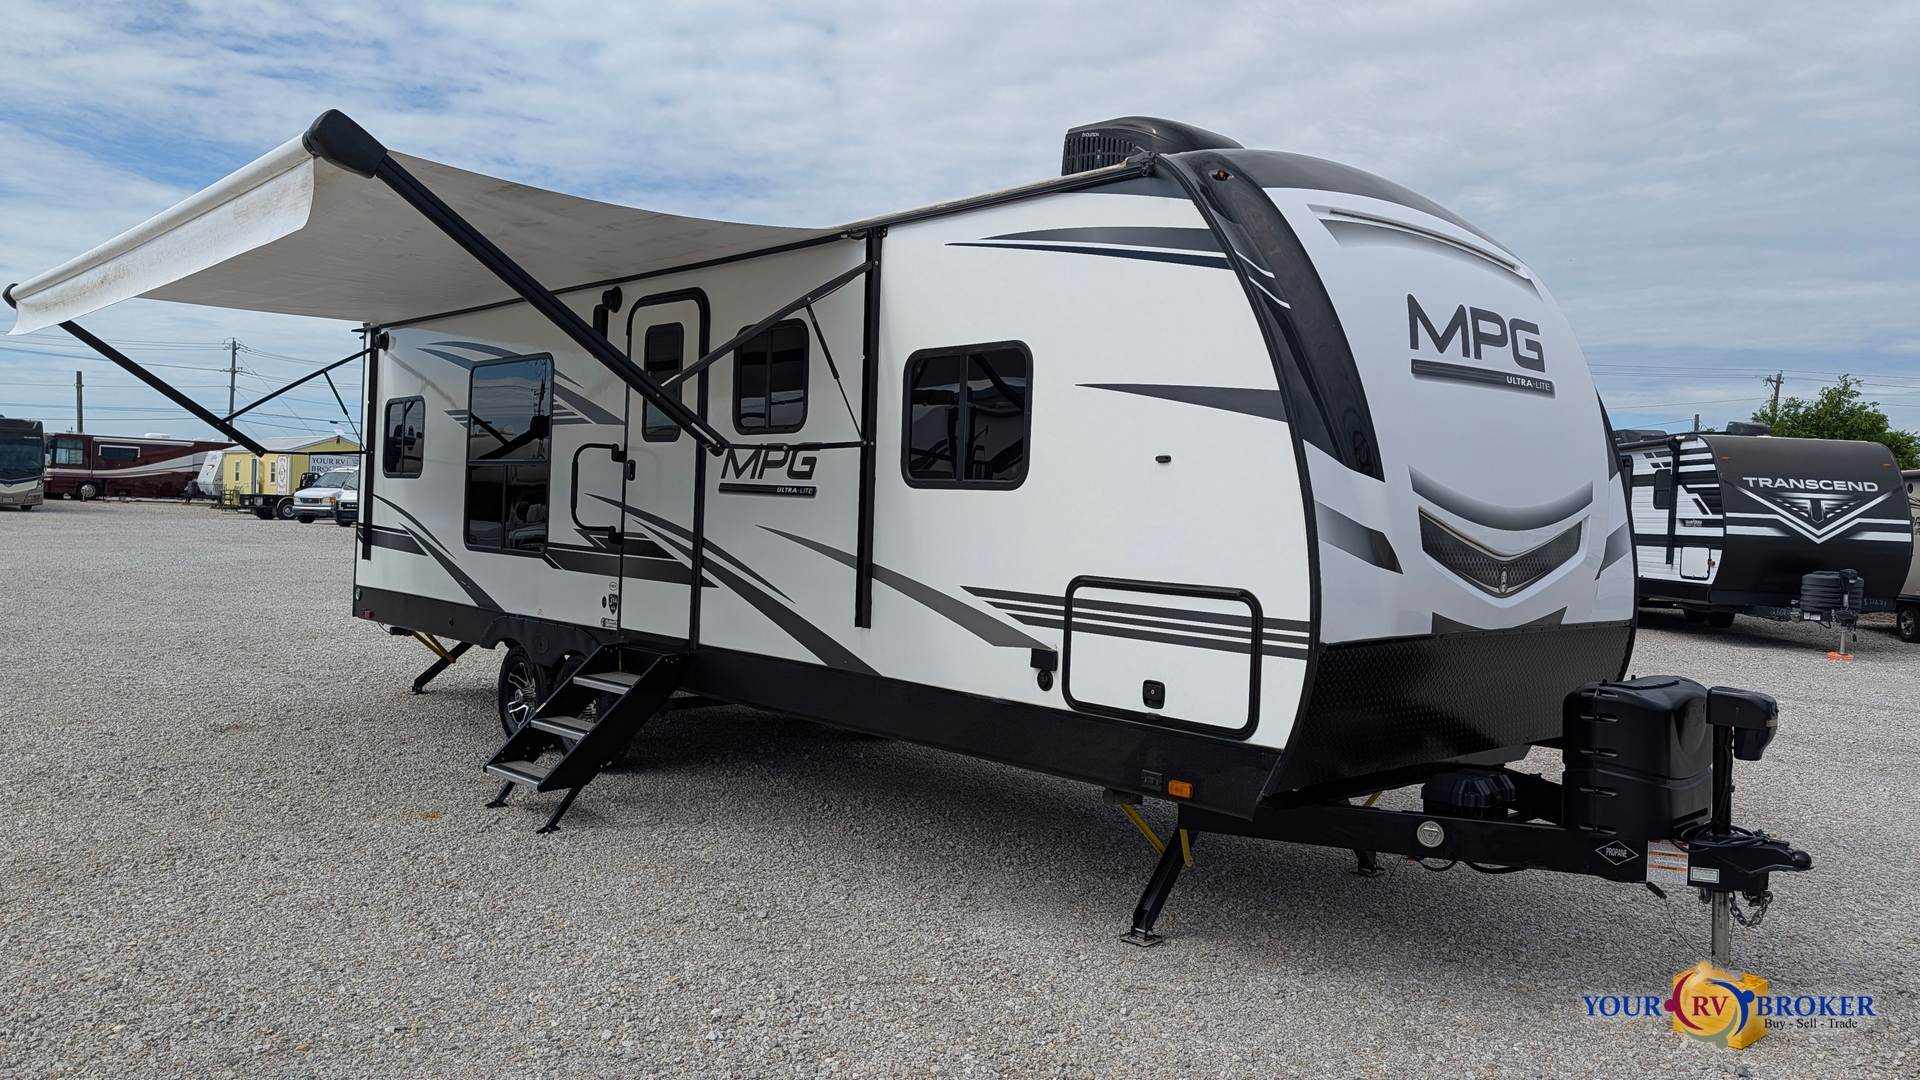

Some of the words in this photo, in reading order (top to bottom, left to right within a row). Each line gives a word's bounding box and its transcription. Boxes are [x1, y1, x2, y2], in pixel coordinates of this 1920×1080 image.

[1407, 293, 1546, 373] MPG
[1506, 376, 1551, 391] ULTRA-LITE
[312, 457, 334, 465] YOUR
[720, 442, 821, 480] MPG
[776, 487, 814, 495] ULTRA-LITE
[1743, 477, 1878, 492] TRANSCEND
[1605, 847, 1628, 858] PROPANE
